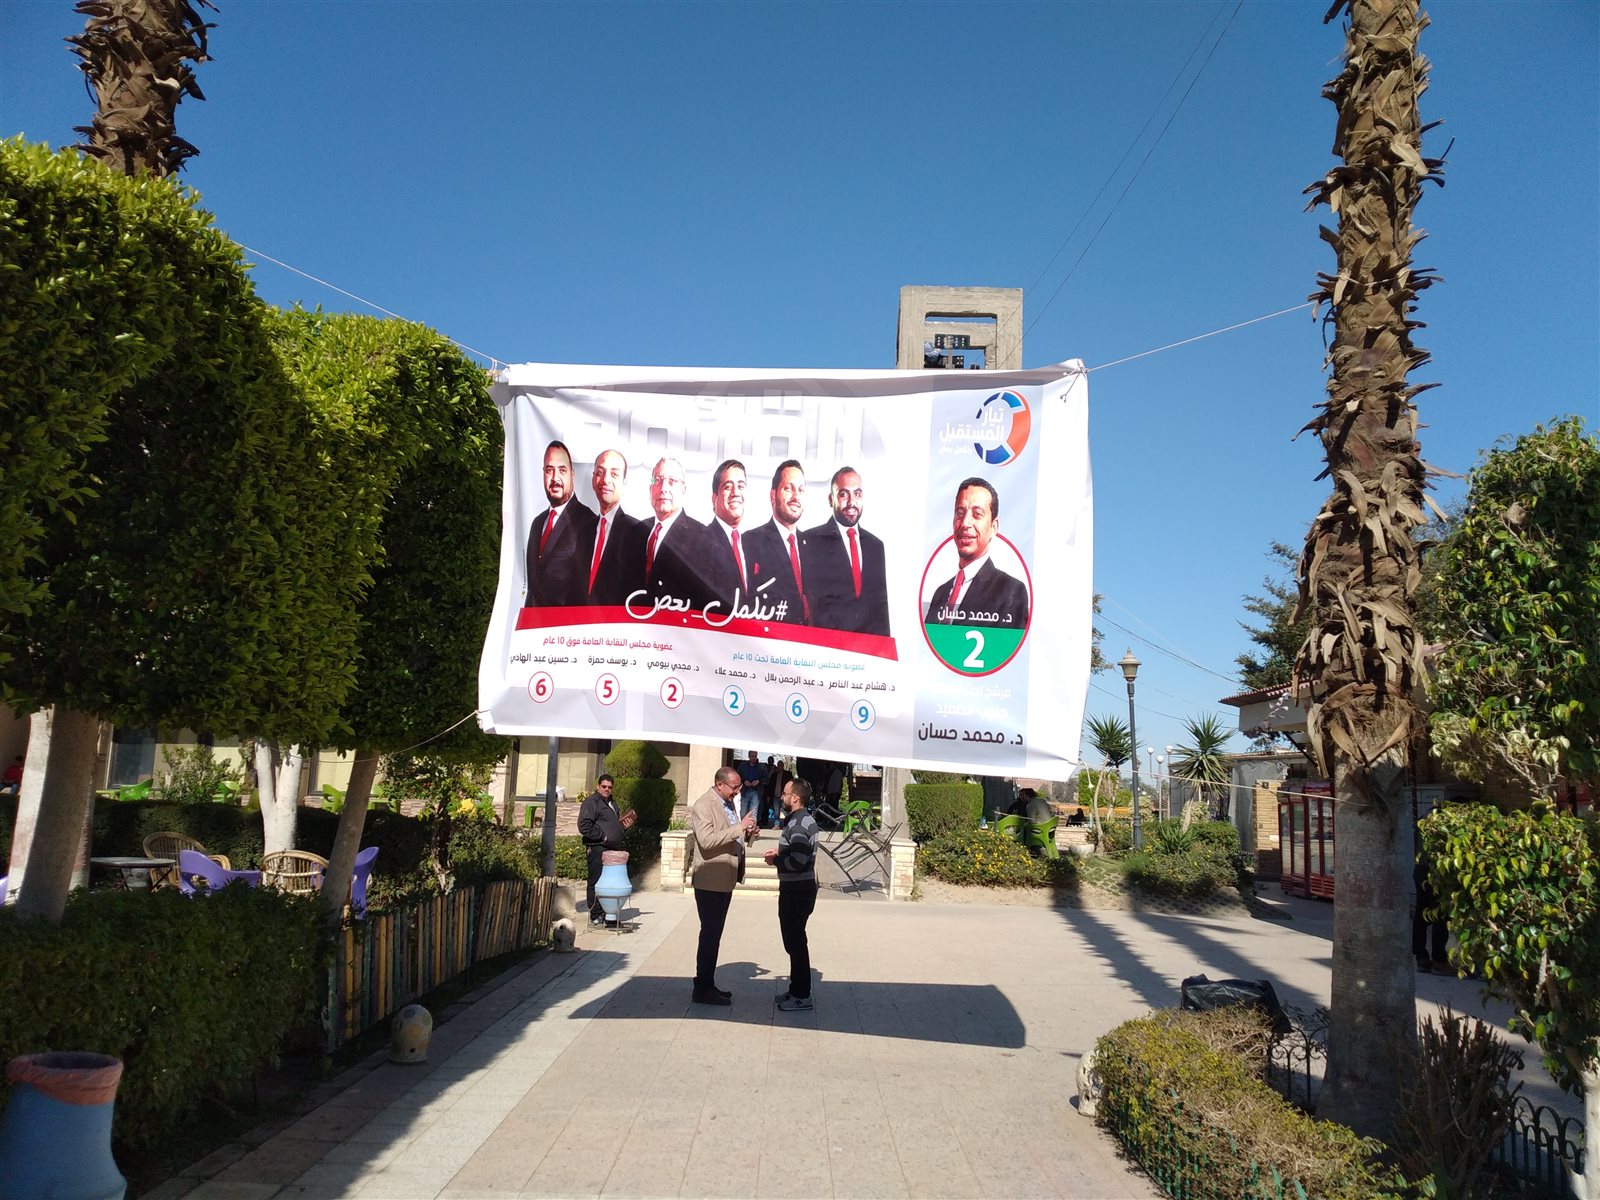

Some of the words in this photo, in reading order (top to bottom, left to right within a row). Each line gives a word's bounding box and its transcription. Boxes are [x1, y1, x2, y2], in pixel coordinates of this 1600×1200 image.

[982, 407, 1004, 426] تيار
[939, 422, 1004, 442] المستقبل
[937, 607, 967, 621] حسان
[968, 610, 999, 622] محمد
[1002, 612, 1013, 623] د.
[543, 636, 555, 646] عام
[566, 637, 581, 647] فوق
[582, 637, 604, 646] العامة
[605, 637, 628, 648] النقابة
[629, 640, 651, 649] مجلس
[652, 641, 673, 651] عضوية
[963, 630, 985, 668] 2
[533, 654, 546, 664] عبد
[548, 655, 569, 665] حسين
[588, 655, 605, 666] حمزة
[607, 656, 628, 667] يوسف
[733, 651, 744, 661] عام
[754, 655, 769, 663] تحت
[770, 656, 791, 665] العامة
[647, 660, 669, 670] بيومي
[671, 663, 692, 672] مجدي
[793, 657, 816, 668] النقابة
[818, 660, 841, 670] مجلس
[714, 667, 727, 676] علاء
[728, 669, 748, 678] محمد
[764, 672, 777, 683] بلال
[778, 674, 801, 685] الرحمن
[803, 678, 815, 688] عبد
[535, 678, 547, 696] 6
[603, 680, 613, 698] 5
[828, 679, 849, 690] الناصر
[851, 682, 863, 691] عبد
[865, 681, 886, 692] هشام
[667, 683, 677, 702] 2
[729, 691, 739, 710] 2
[791, 699, 802, 717] 6
[858, 706, 869, 724] 9
[918, 722, 958, 740] حسان
[962, 730, 1005, 744] محمد
[1010, 733, 1023, 745] د.
